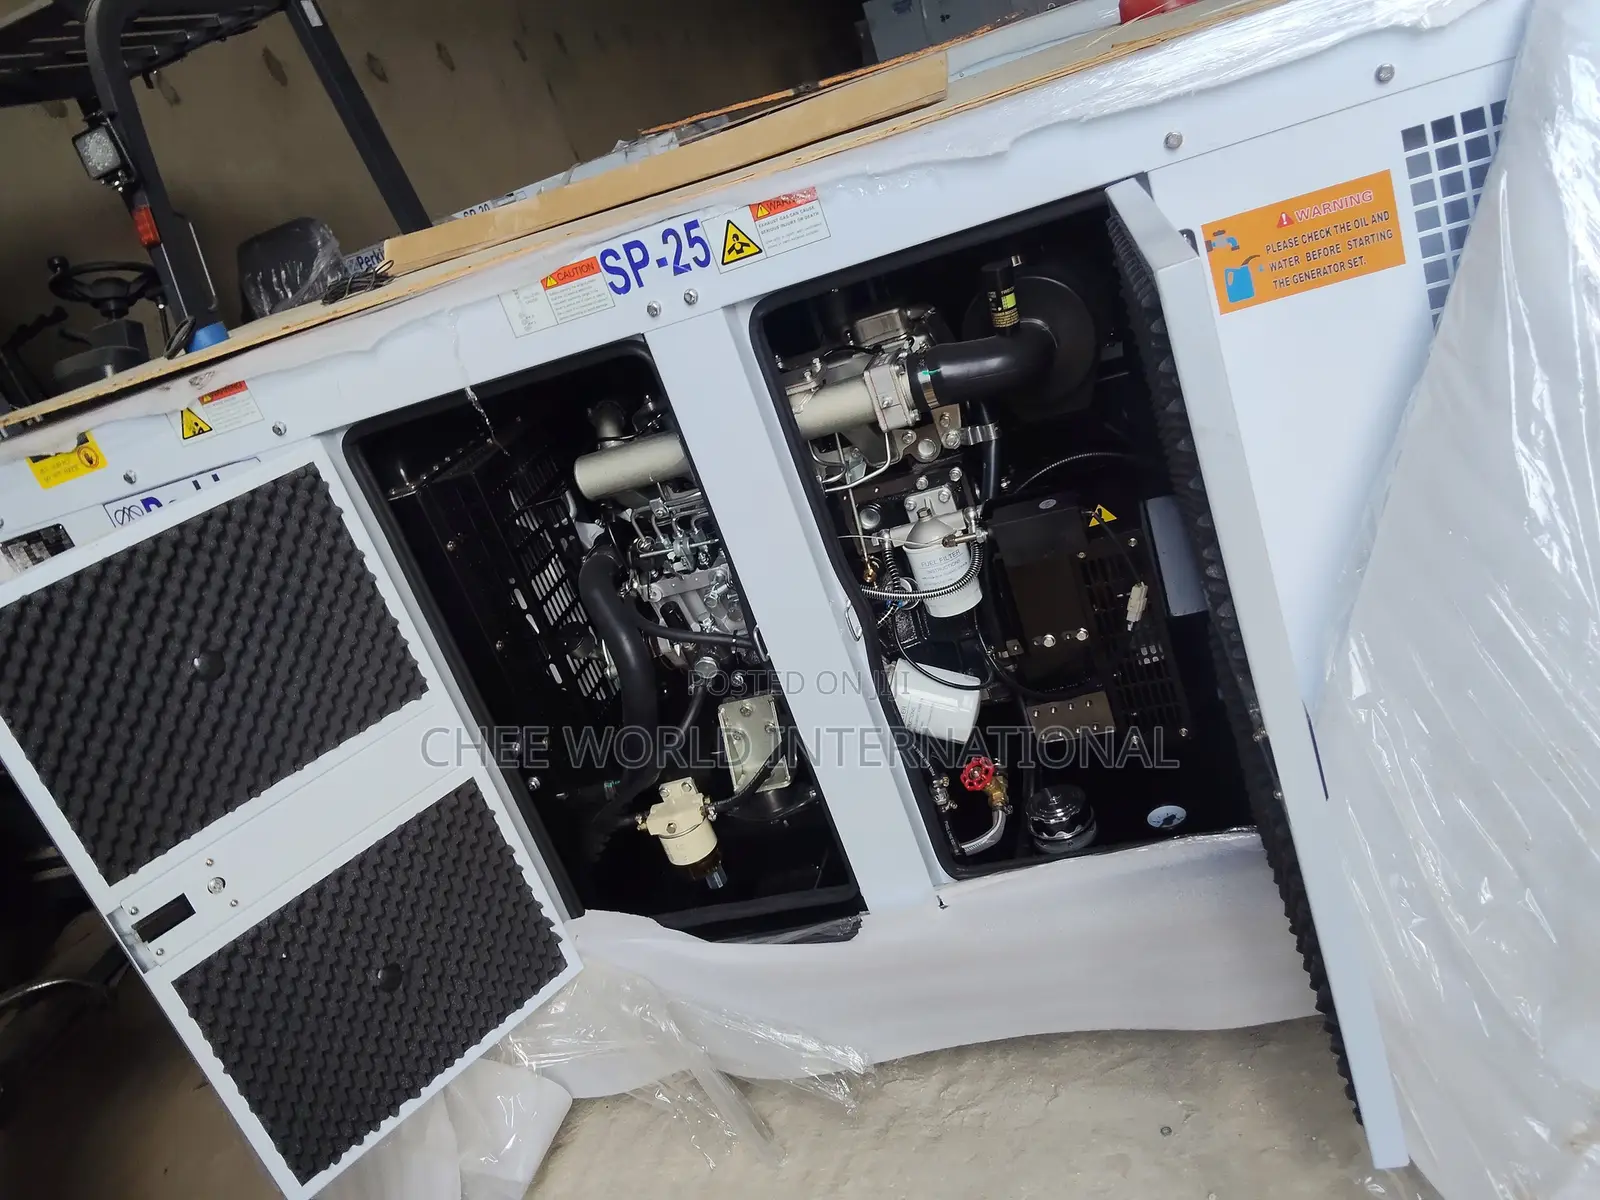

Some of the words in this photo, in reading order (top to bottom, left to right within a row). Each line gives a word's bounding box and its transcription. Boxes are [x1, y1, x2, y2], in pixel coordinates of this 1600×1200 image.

[1294, 189, 1374, 223] WARNING
[1265, 236, 1300, 255] PLEASE
[1301, 228, 1333, 247] CHECK
[1333, 221, 1352, 236] THE
[1354, 215, 1370, 230] OIL
[1370, 210, 1391, 225] AND
[599, 218, 711, 295] SP-25
[1268, 255, 1301, 273] WATER
[1305, 242, 1342, 263] BEFORE
[1347, 229, 1394, 251] STARTING
[556, 261, 595, 282] CAUTION
[1272, 275, 1291, 290] THE
[1292, 262, 1346, 285] GENERATOR
[1347, 256, 1367, 272] SET.
[939, 548, 961, 563] FILTER
